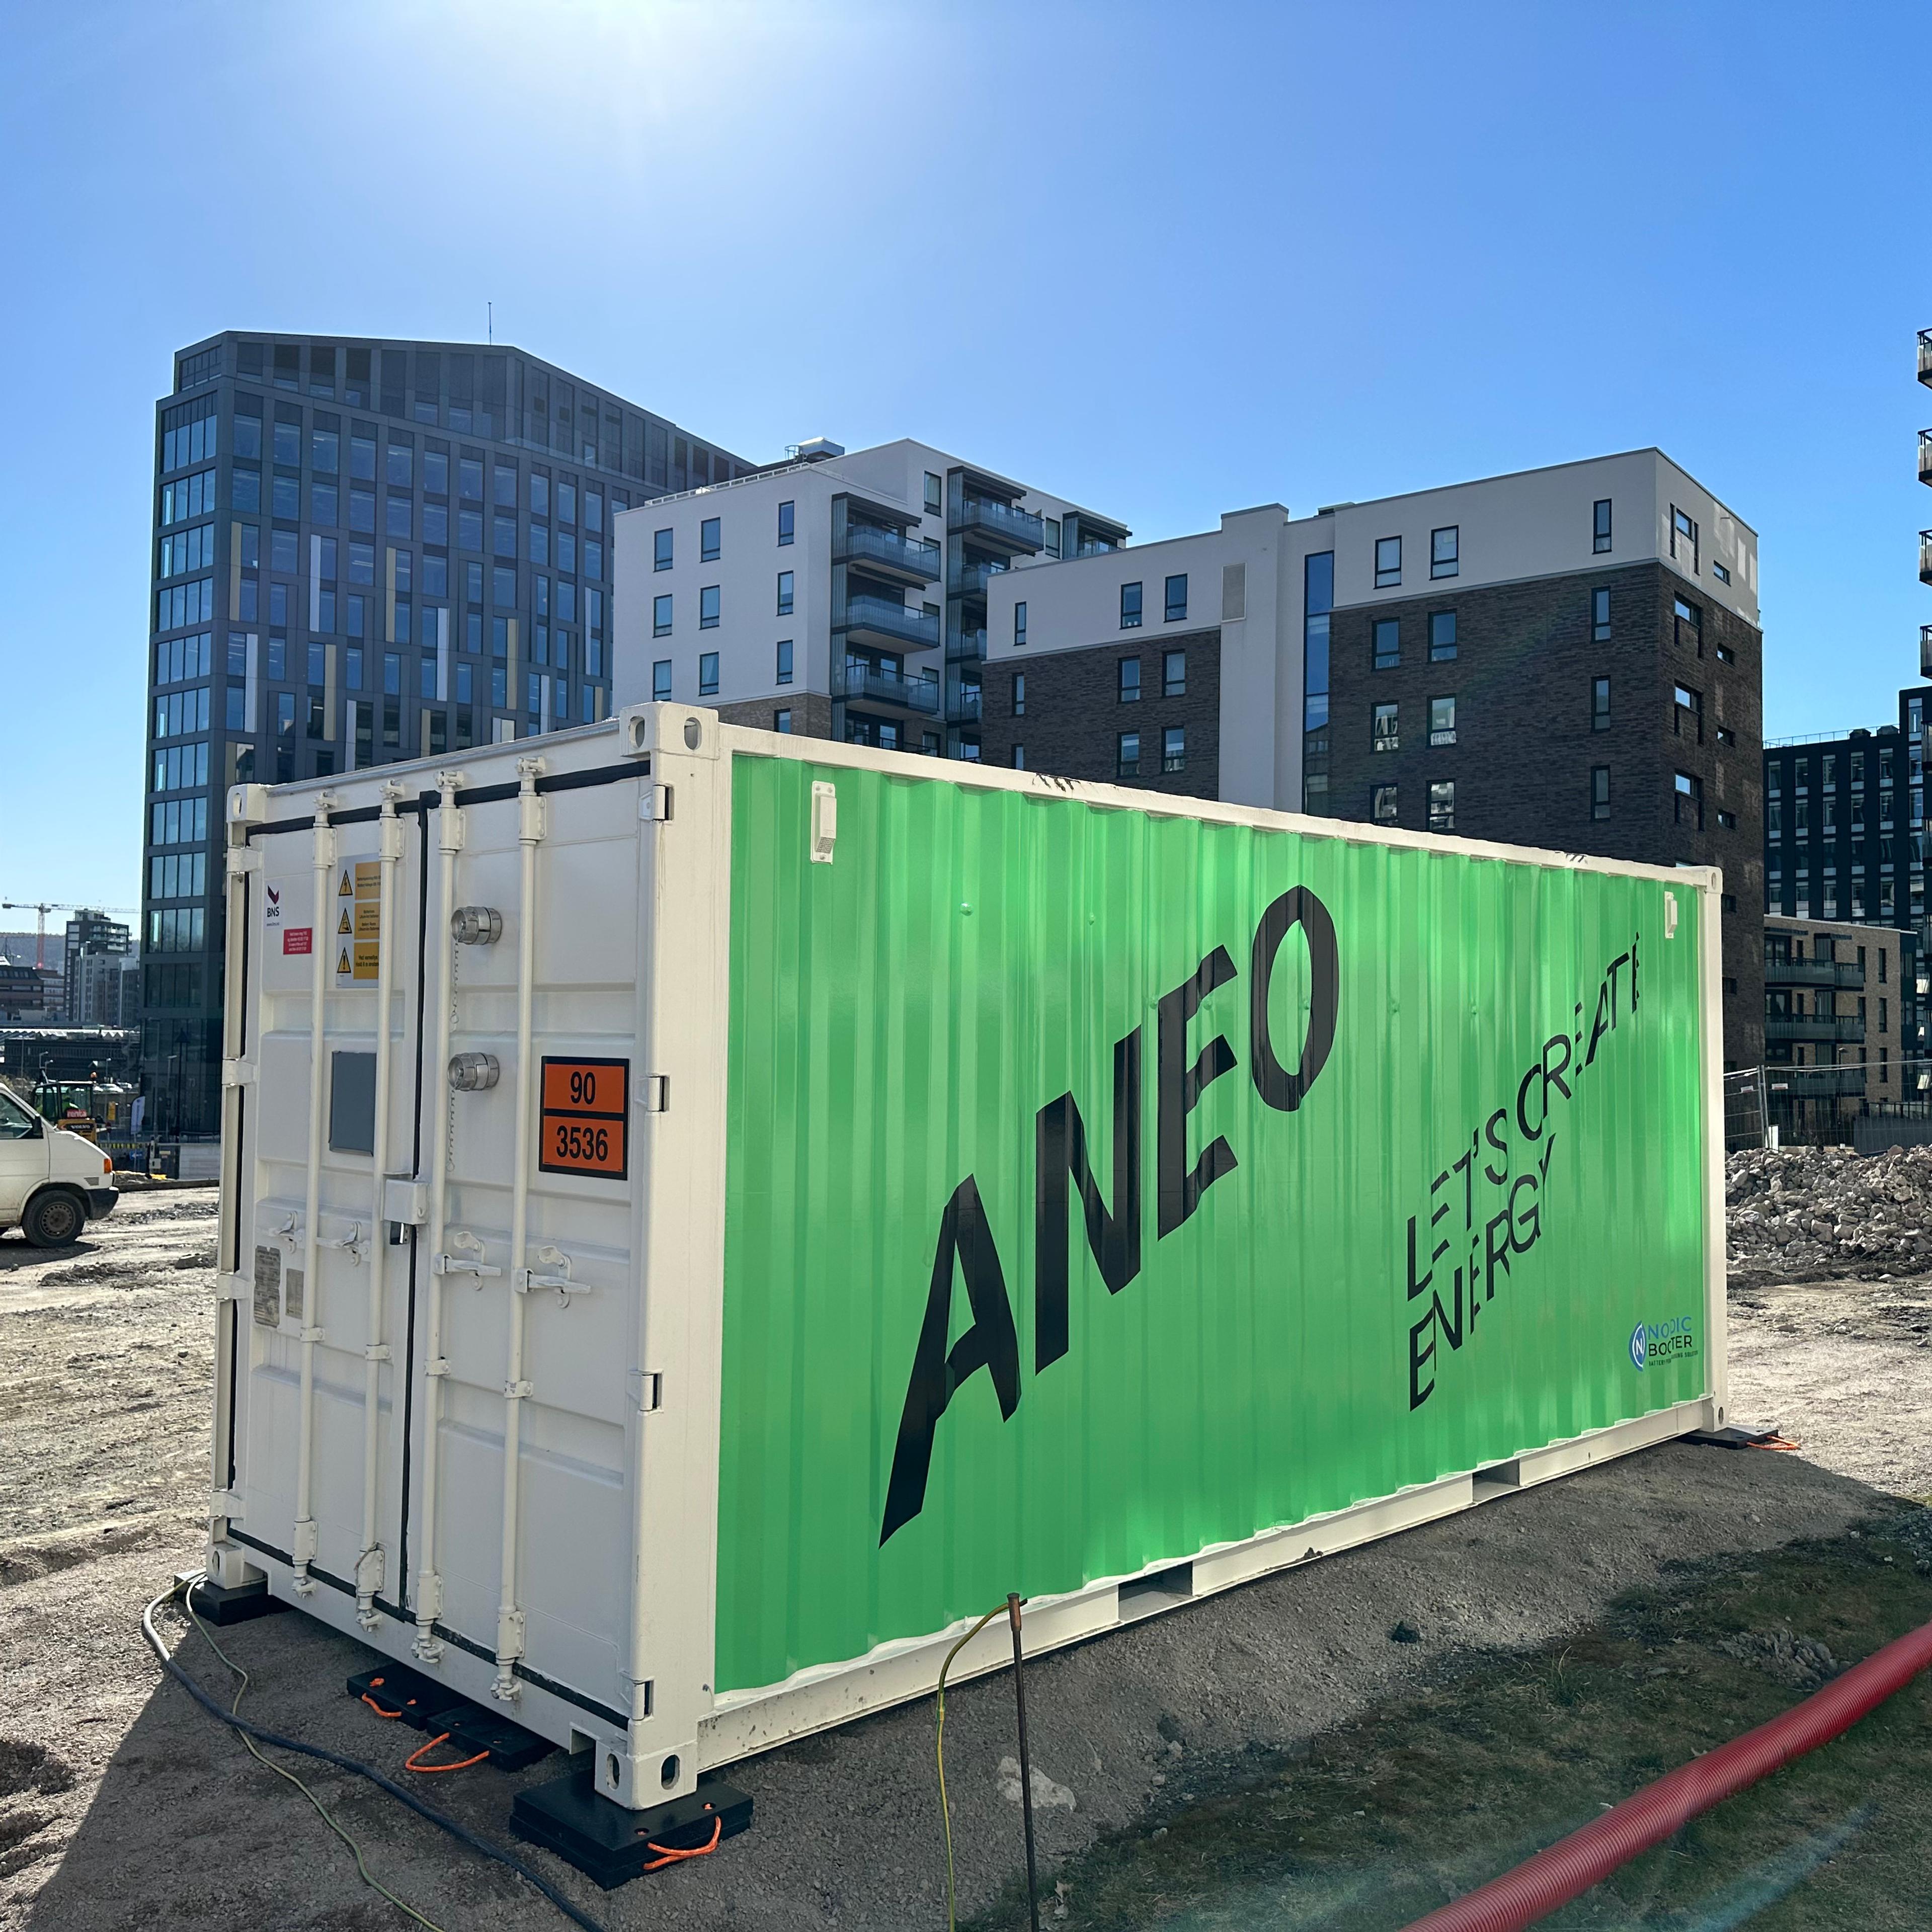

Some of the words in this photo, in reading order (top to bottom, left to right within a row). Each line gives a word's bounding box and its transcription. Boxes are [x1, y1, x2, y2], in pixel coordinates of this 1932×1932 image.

[267, 906, 279, 918] BNS
[556, 1125, 608, 1162] 3536
[570, 1071, 596, 1105] 90
[879, 884, 1339, 1550] ANEO
[1407, 1108, 1508, 1302] LET'S
[1410, 1133, 1556, 1412] ENERGY
